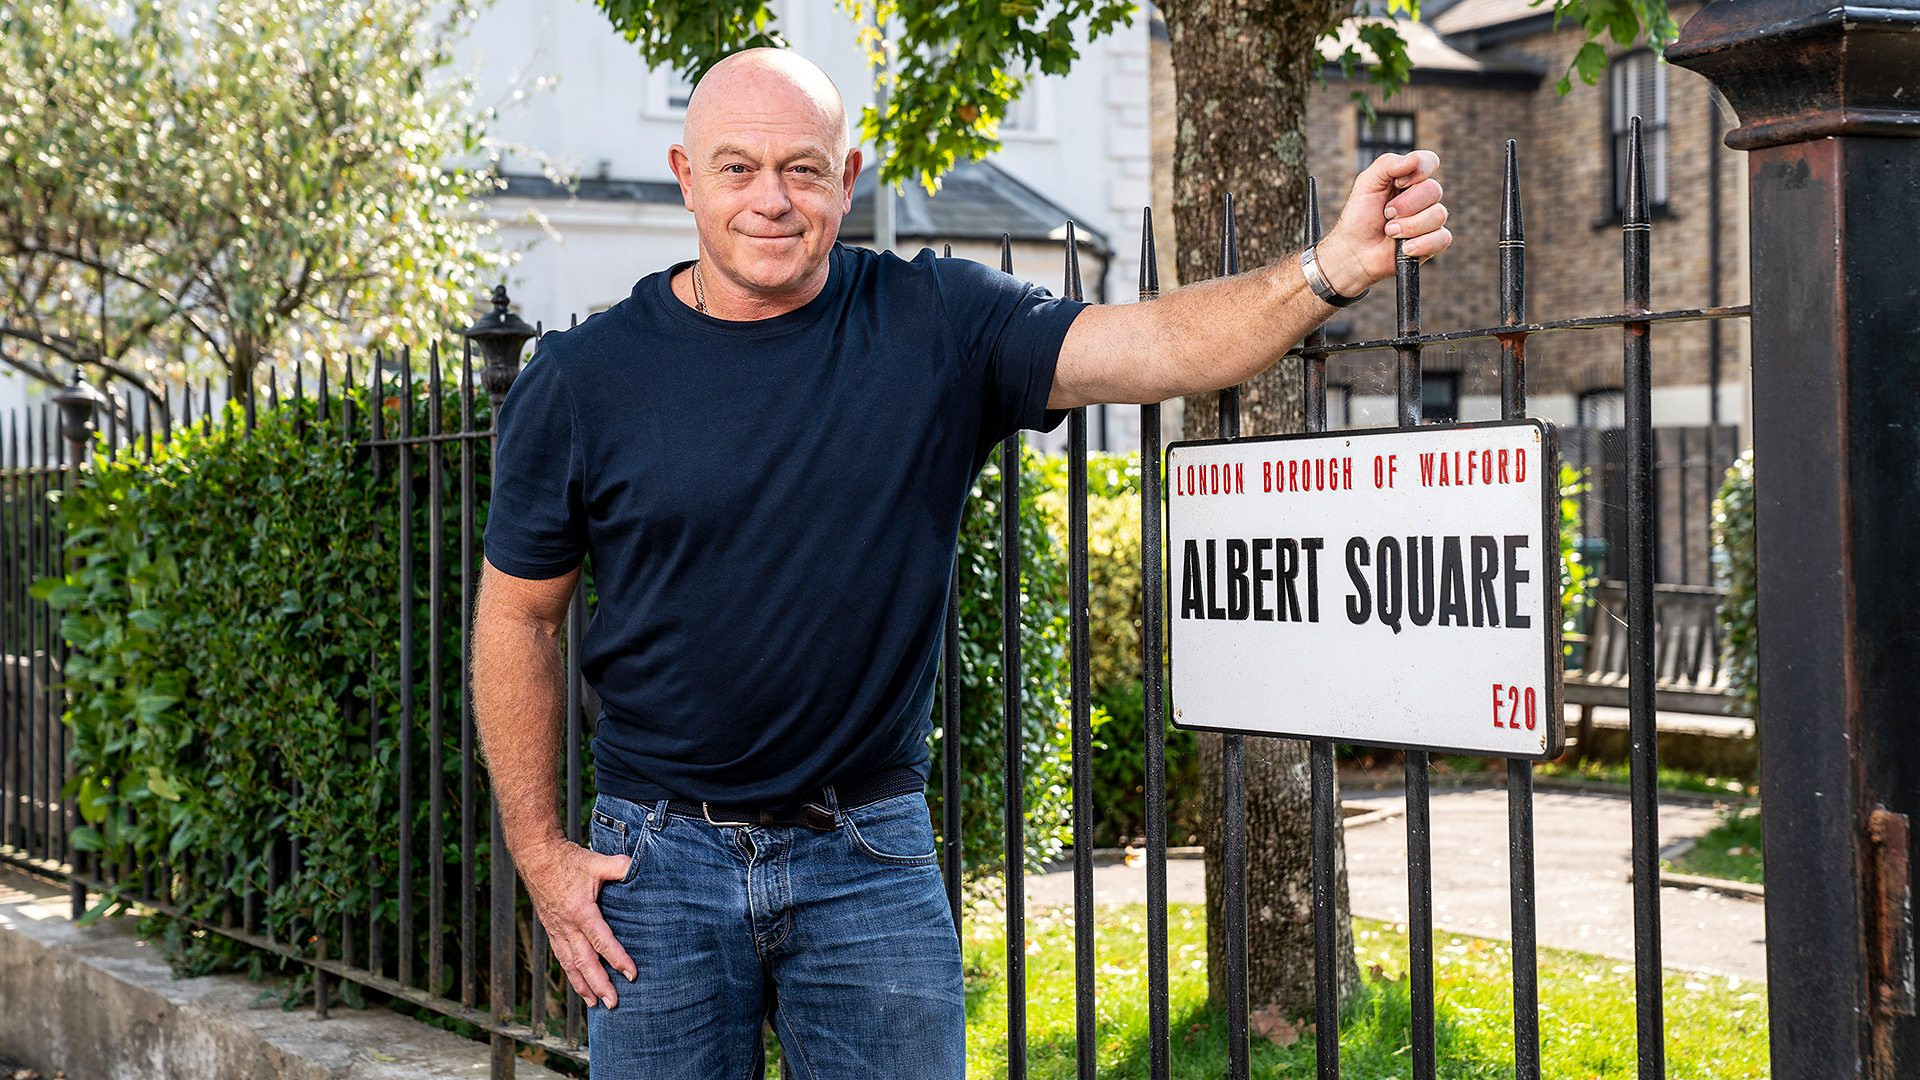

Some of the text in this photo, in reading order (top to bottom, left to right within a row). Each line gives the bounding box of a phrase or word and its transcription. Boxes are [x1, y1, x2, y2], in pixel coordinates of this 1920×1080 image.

[1176, 447, 1527, 497] LONDON BOROUGH OF WALFORD
[1180, 534, 1532, 635] ALBERT SQUARE
[1492, 683, 1537, 731] E20
